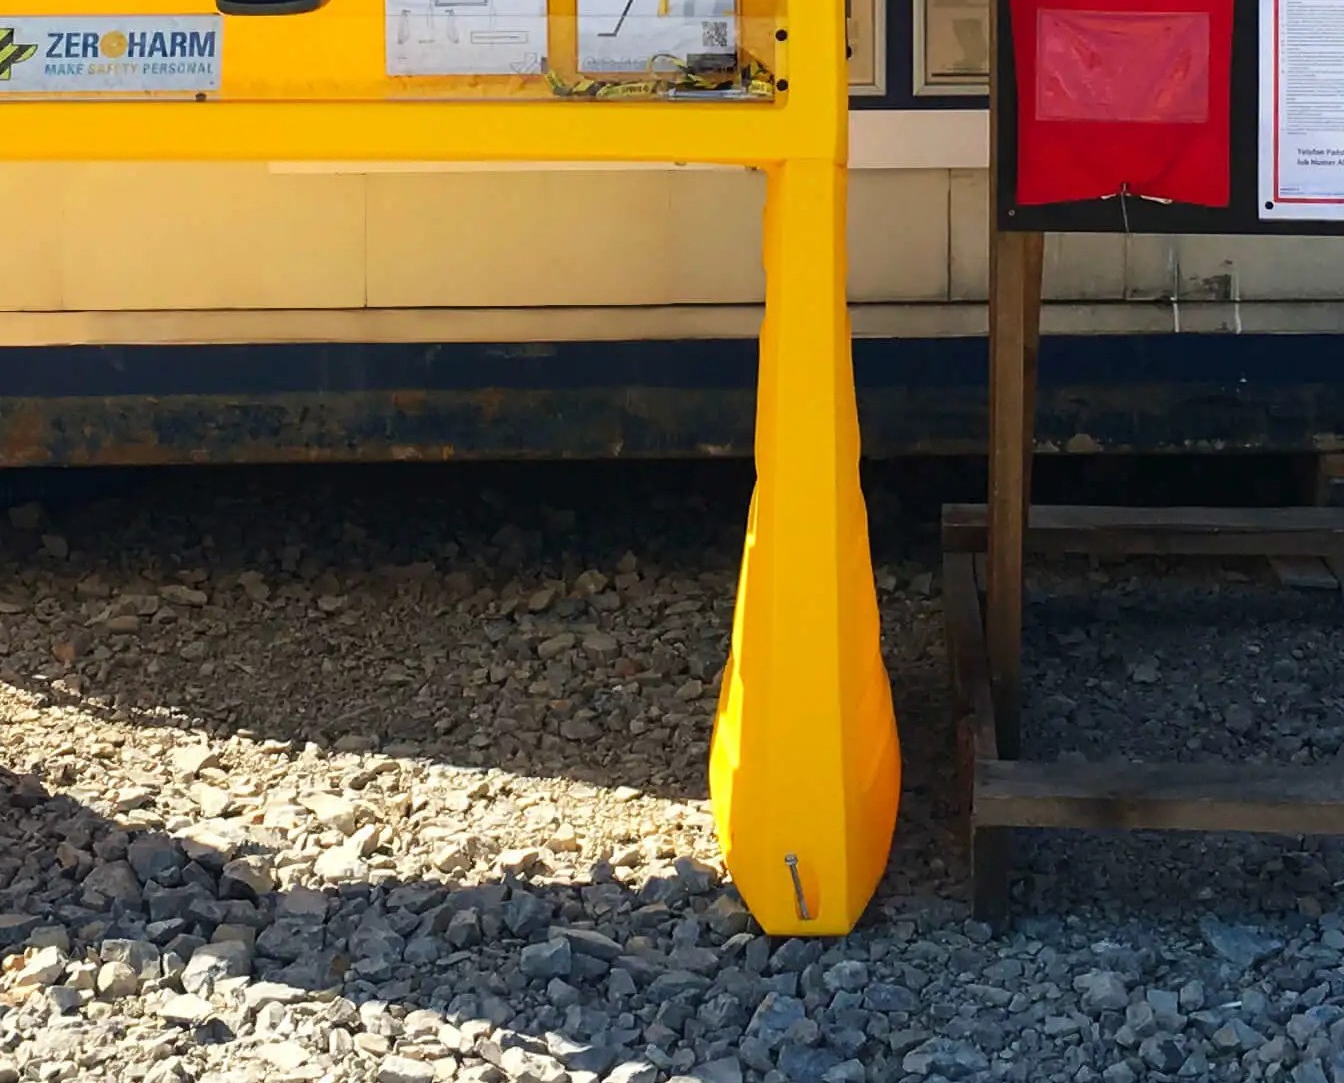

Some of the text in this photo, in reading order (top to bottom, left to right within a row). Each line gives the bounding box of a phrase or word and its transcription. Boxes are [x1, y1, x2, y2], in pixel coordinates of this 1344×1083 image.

[45, 62, 213, 75] MAKE SAFETY PERSONAL
